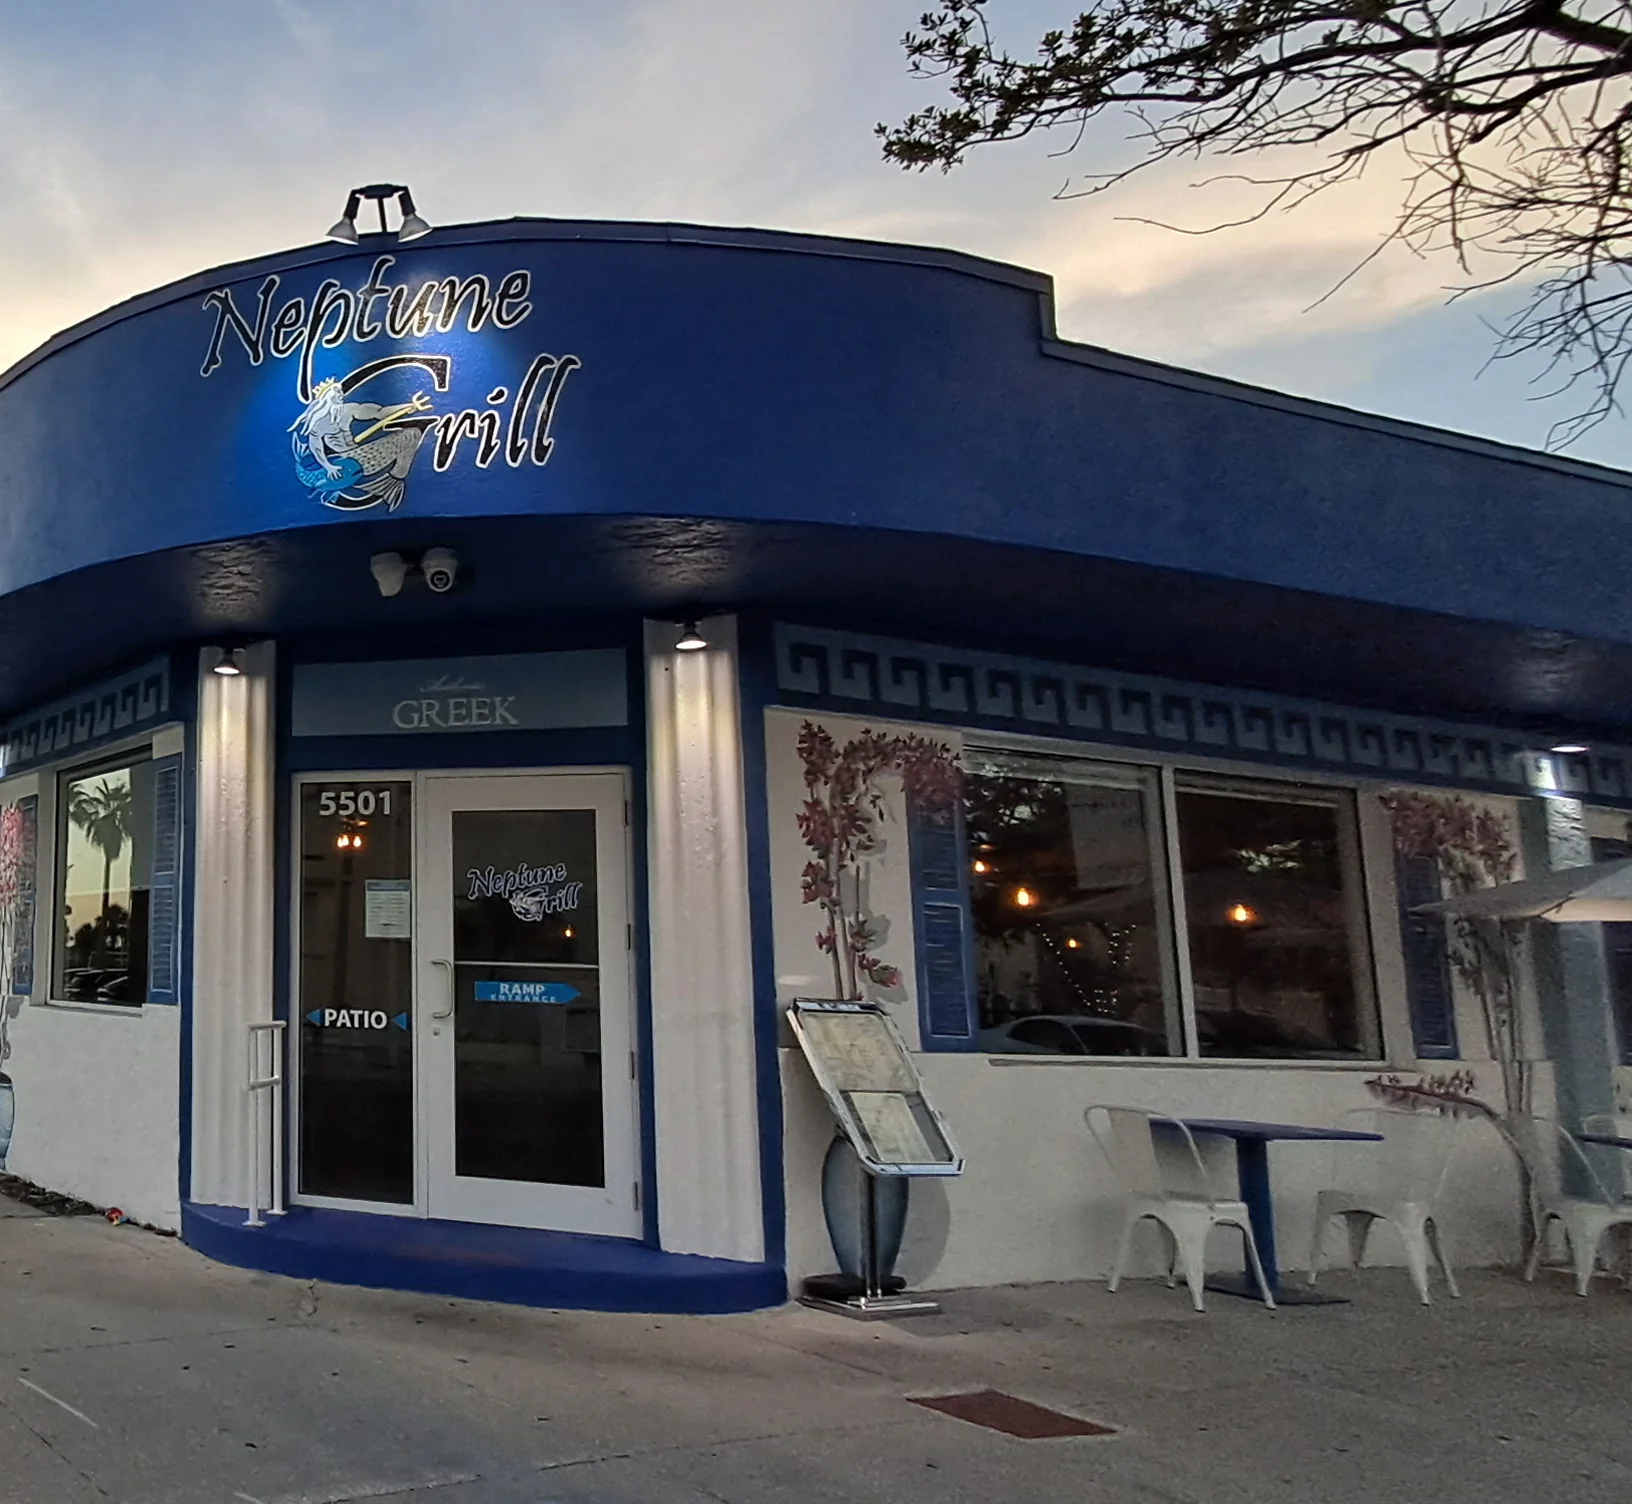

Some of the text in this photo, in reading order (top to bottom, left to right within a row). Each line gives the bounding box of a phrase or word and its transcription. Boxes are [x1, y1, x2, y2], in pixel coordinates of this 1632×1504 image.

[200, 255, 532, 403] Neptune
[319, 353, 581, 511] Grill
[392, 696, 520, 729] GREEK
[319, 790, 391, 816] 5501
[467, 862, 568, 900] Neptune
[511, 881, 583, 922] Grill
[499, 982, 546, 996] RAMP
[324, 1008, 388, 1030] PATIO
